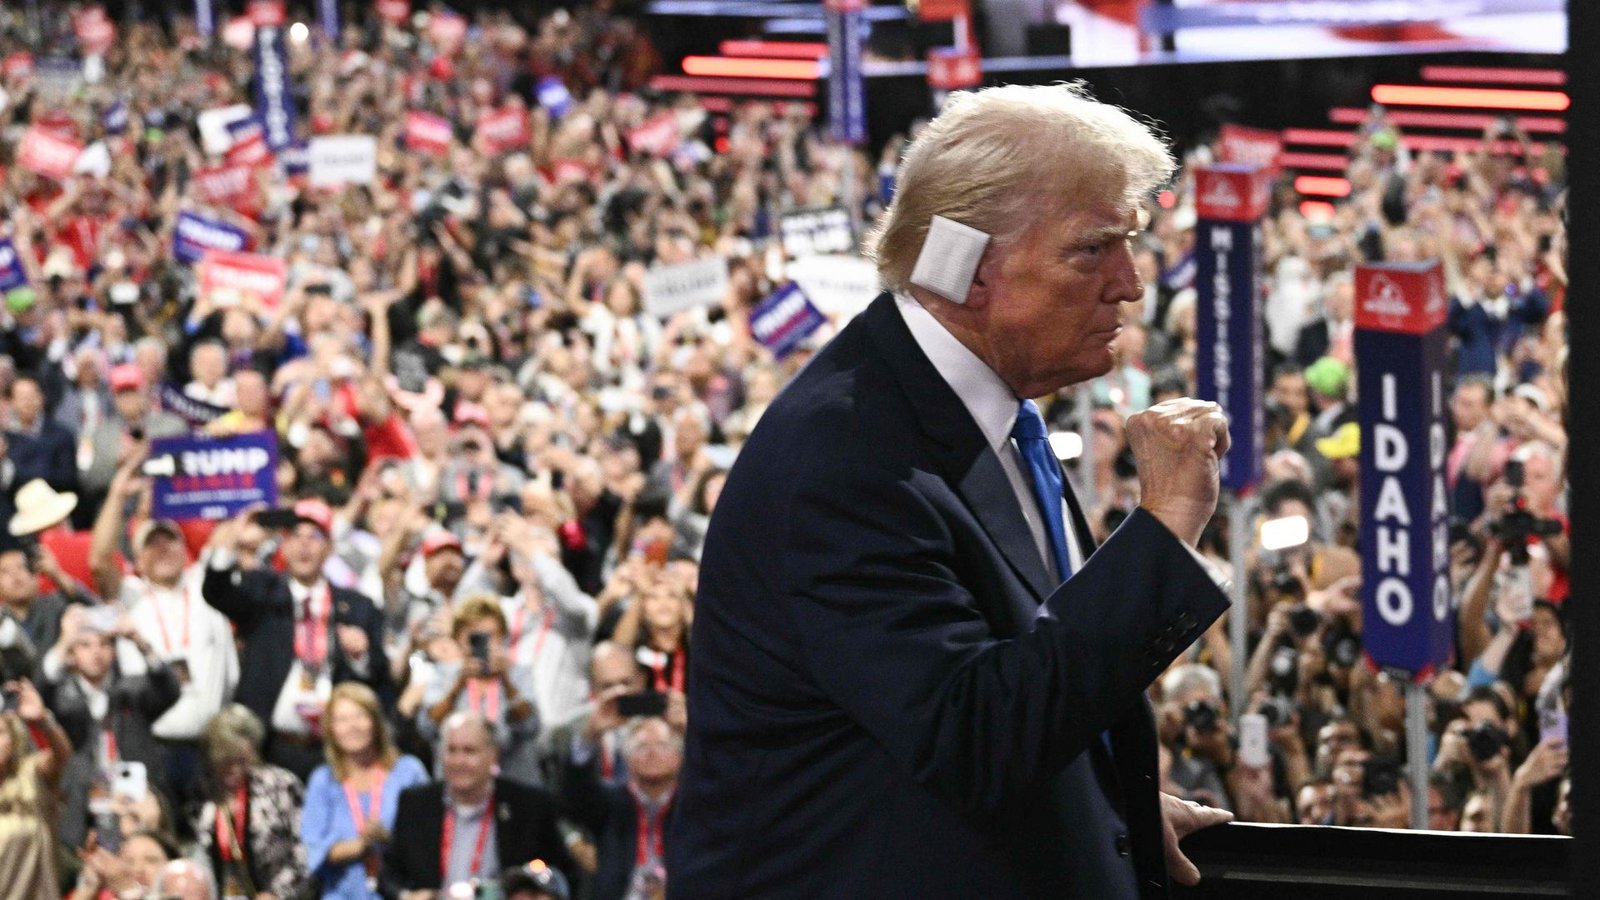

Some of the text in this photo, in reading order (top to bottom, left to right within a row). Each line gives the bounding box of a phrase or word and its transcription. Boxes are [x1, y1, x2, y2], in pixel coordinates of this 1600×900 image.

[182, 447, 269, 476] RUMP
[1374, 373, 1412, 625] IDAHO
[1429, 371, 1449, 621] IDAHO
